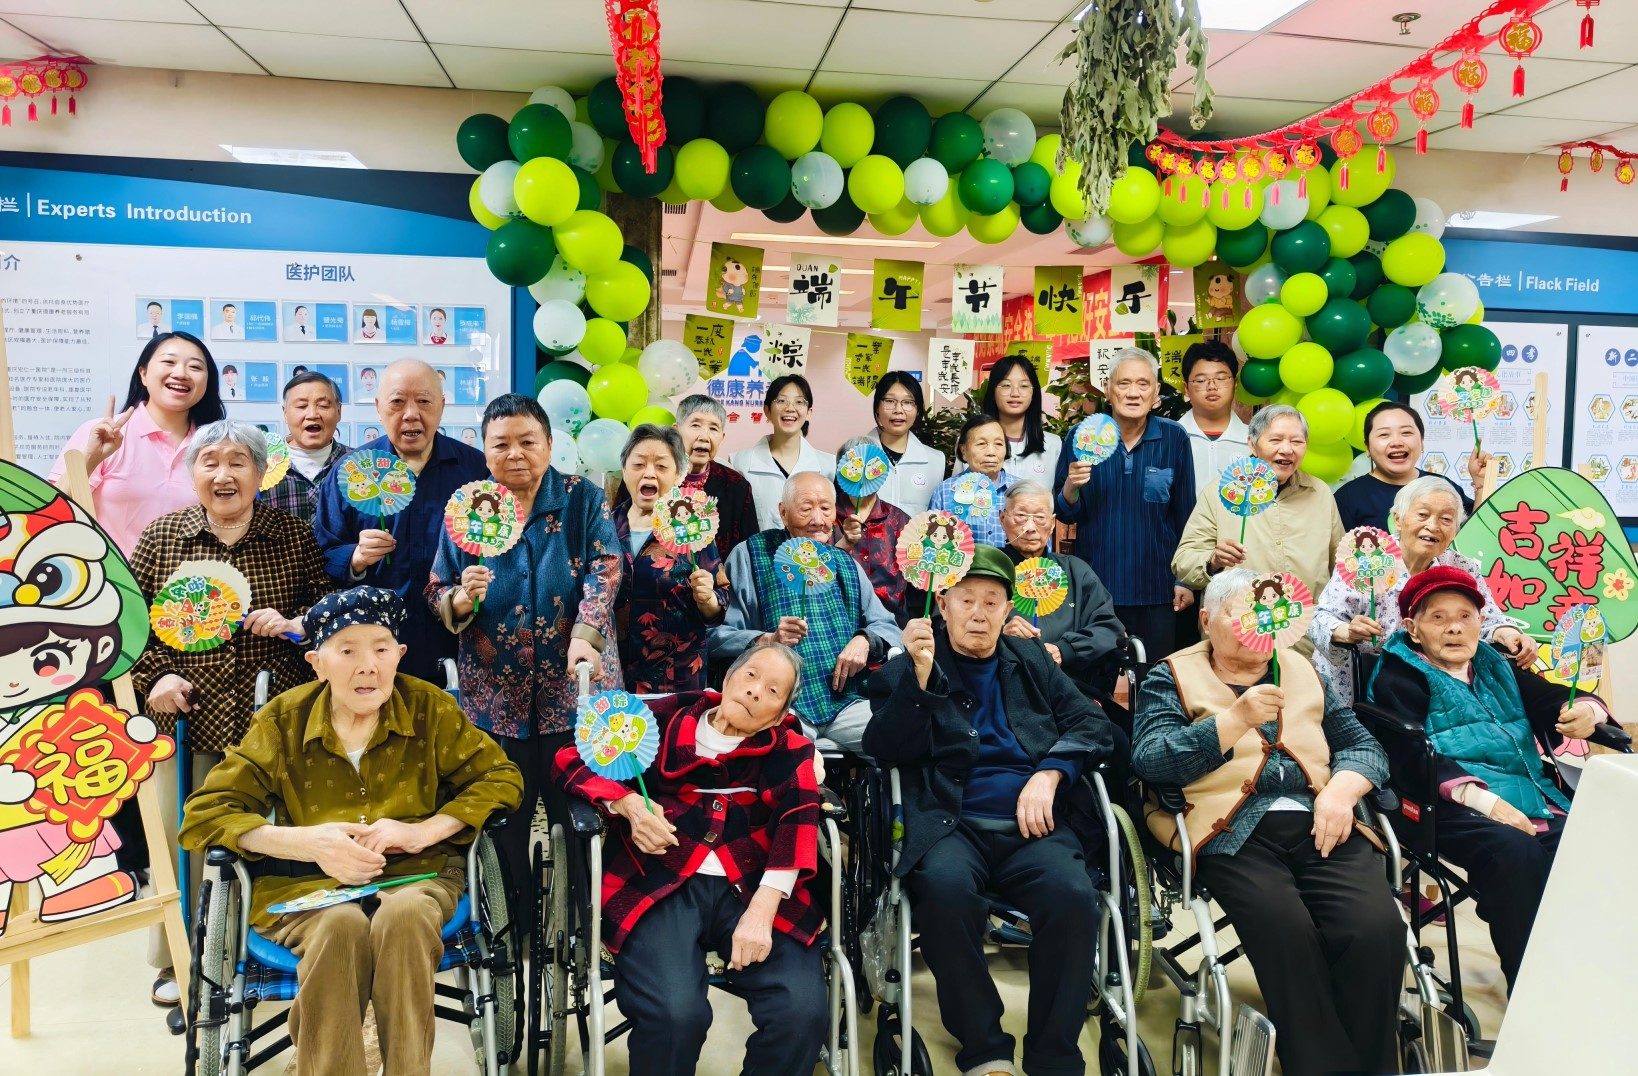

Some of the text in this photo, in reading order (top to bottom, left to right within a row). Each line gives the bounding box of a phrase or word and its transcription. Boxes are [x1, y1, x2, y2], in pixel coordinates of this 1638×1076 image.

[1507, 22, 1533, 52] 福
[1458, 61, 1480, 86] 福
[37, 198, 253, 225] Experts Introduction
[0, 254, 21, 271] 介
[285, 262, 356, 283] 医护团队
[789, 272, 1152, 315] 端 午 节 快 乐
[1526, 275, 1600, 292] Flack Field
[768, 338, 803, 368] 粽
[725, 399, 744, 407] KANG
[34, 723, 129, 806] 福
